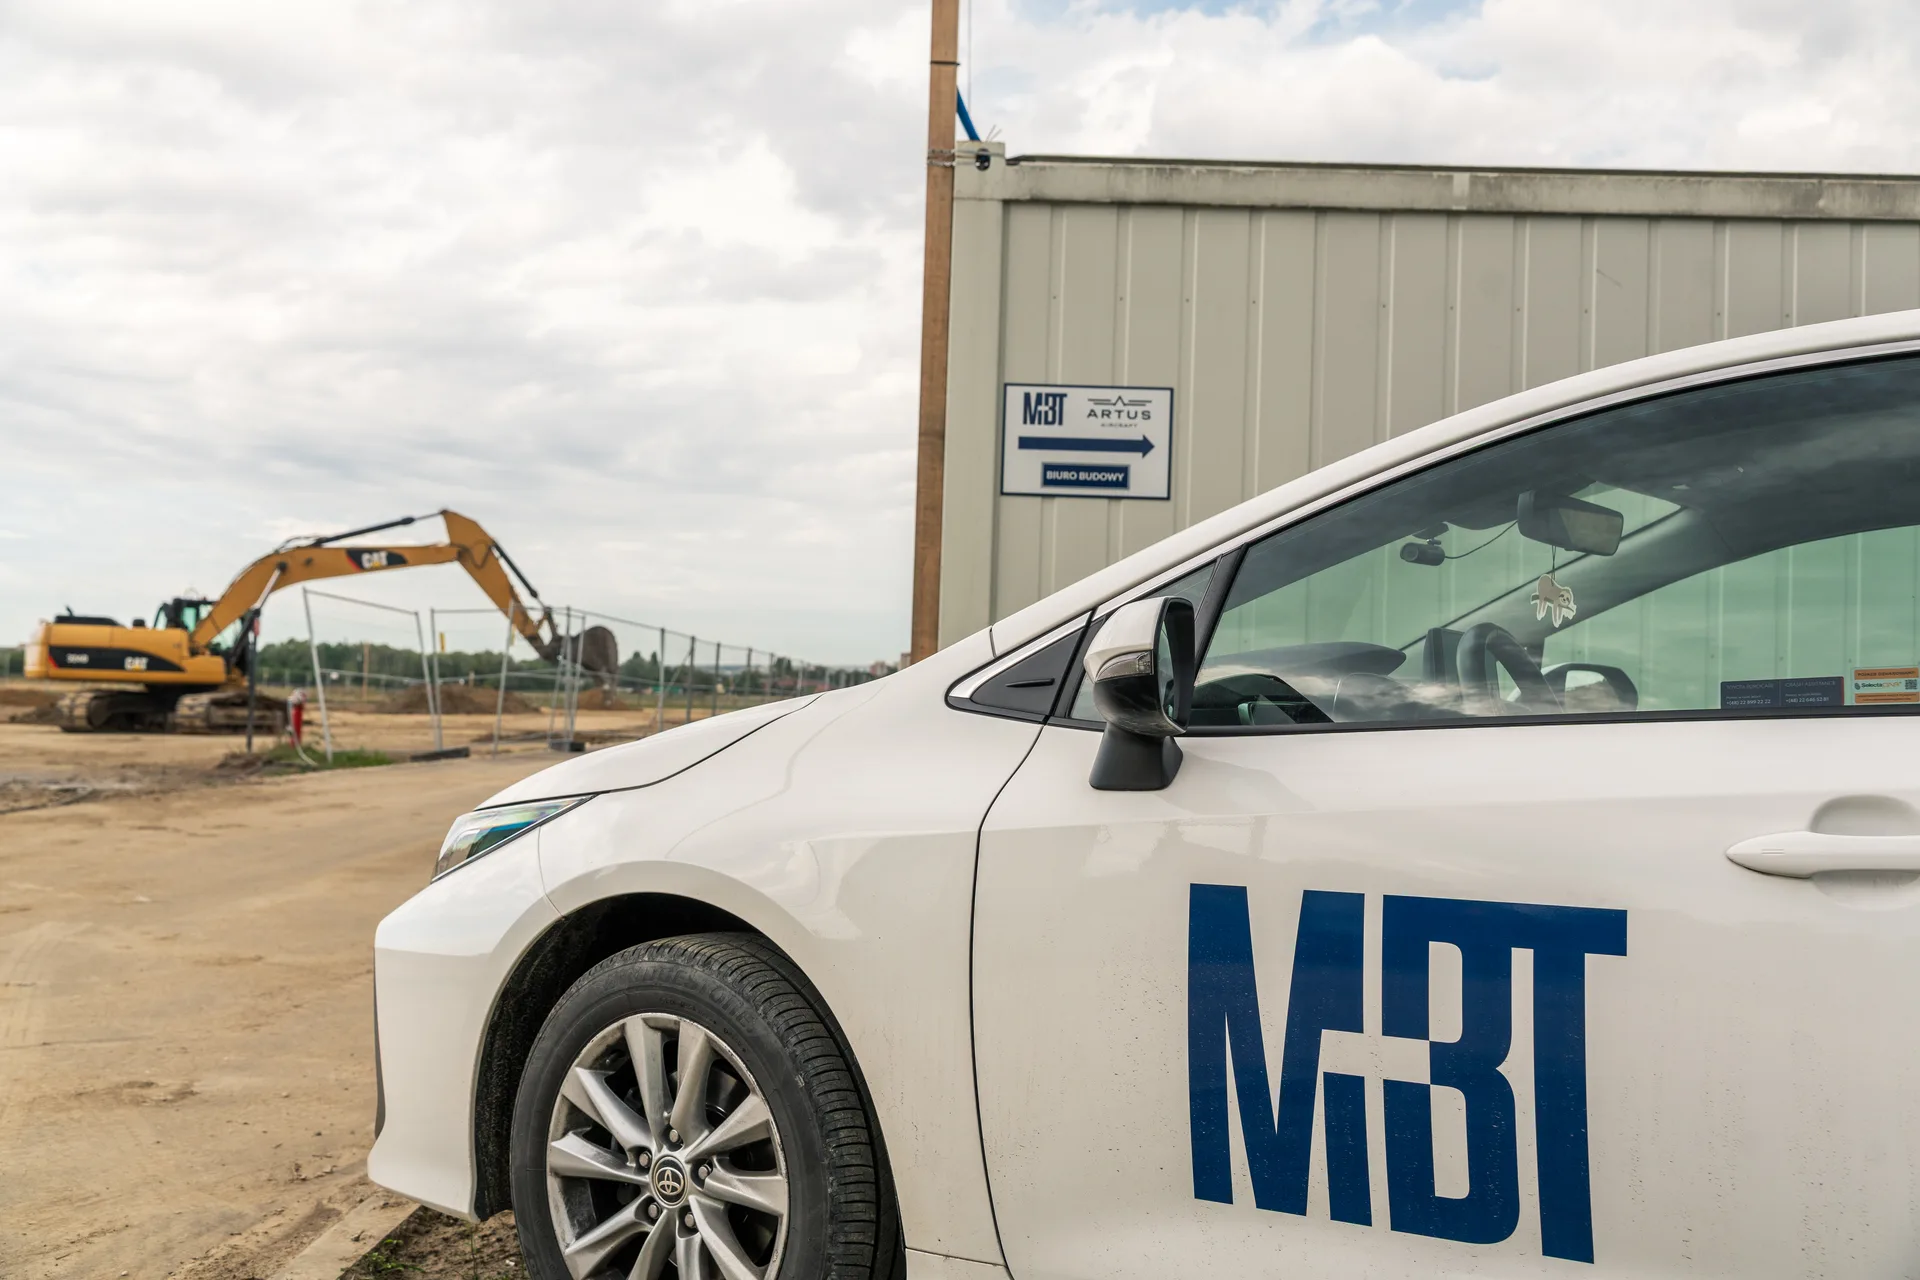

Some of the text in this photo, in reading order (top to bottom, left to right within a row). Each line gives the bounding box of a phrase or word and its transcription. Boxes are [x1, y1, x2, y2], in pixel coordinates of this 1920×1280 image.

[1023, 392, 1067, 426] MBT
[1087, 409, 1151, 421] ARTUS
[1046, 470, 1124, 482] BIURO BUDOWY
[361, 551, 388, 568] CAT
[124, 656, 149, 671] CAT
[1188, 883, 1627, 1264] MBT
